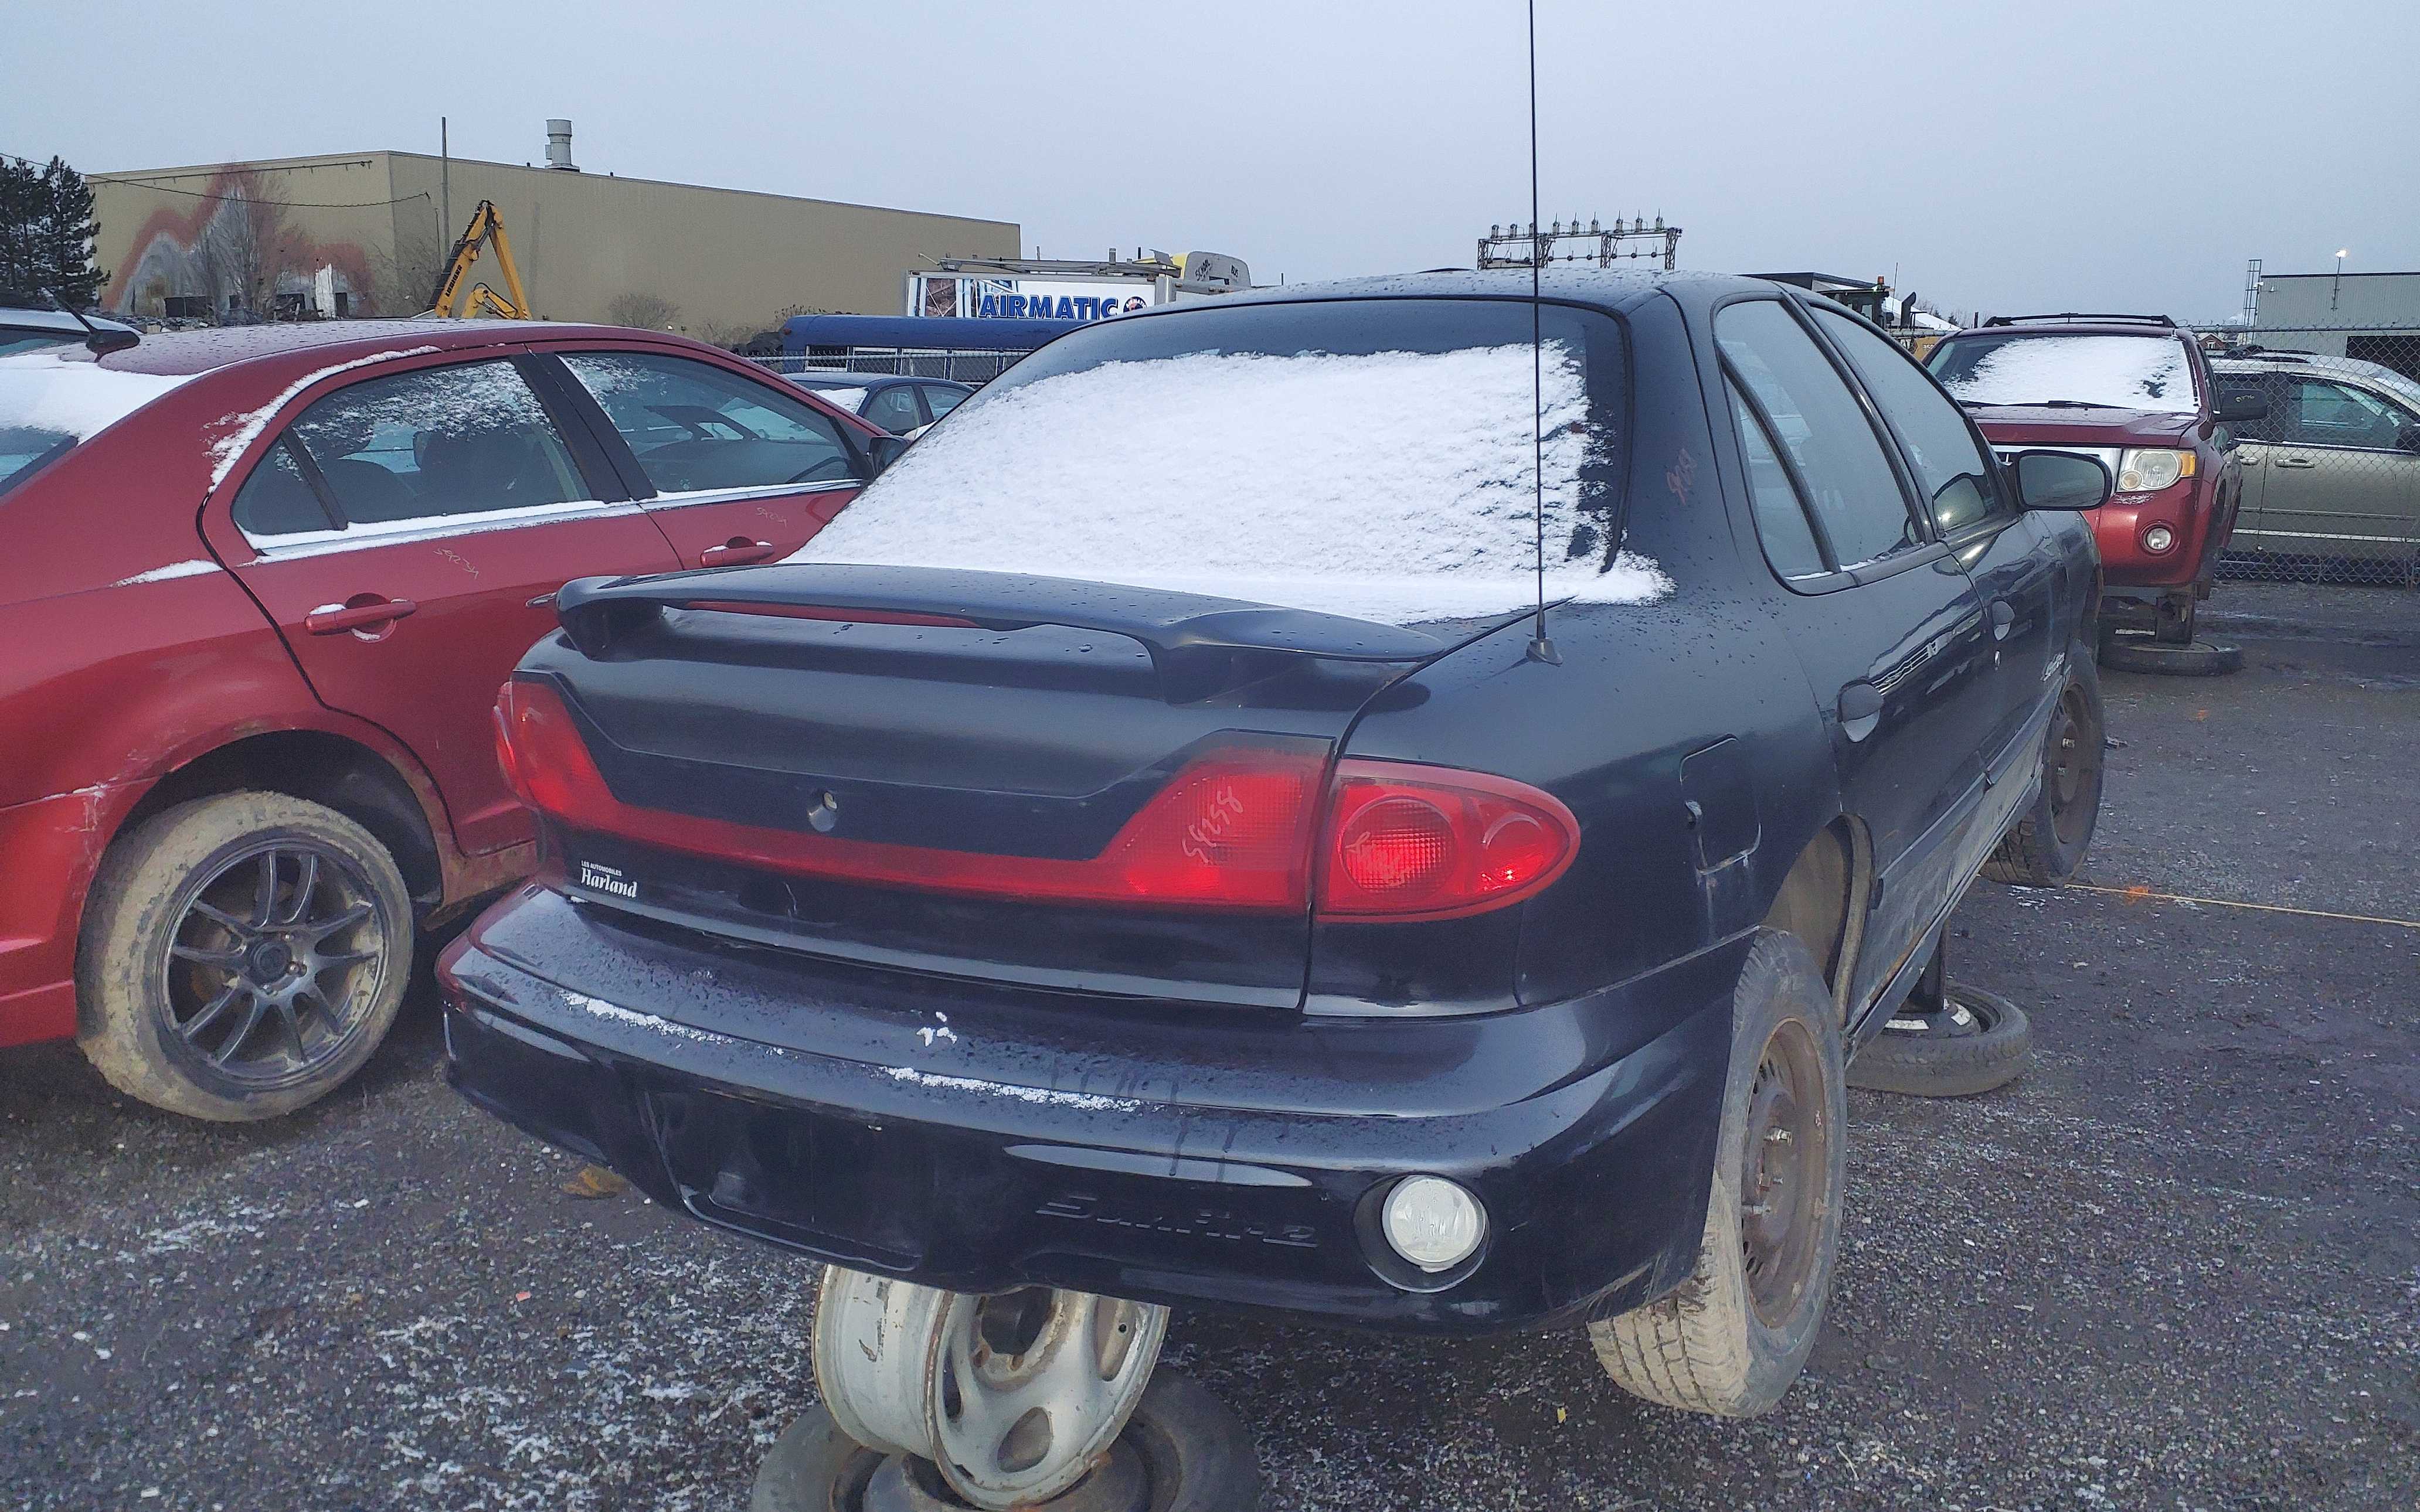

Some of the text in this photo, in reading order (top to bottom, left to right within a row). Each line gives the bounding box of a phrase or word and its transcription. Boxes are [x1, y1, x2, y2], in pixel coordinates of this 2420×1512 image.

[1231, 264, 1239, 278] BUS
[978, 294, 1119, 320] AIRMATIC
[590, 863, 622, 877] AUTOMOBILES
[580, 867, 637, 898] Harland
